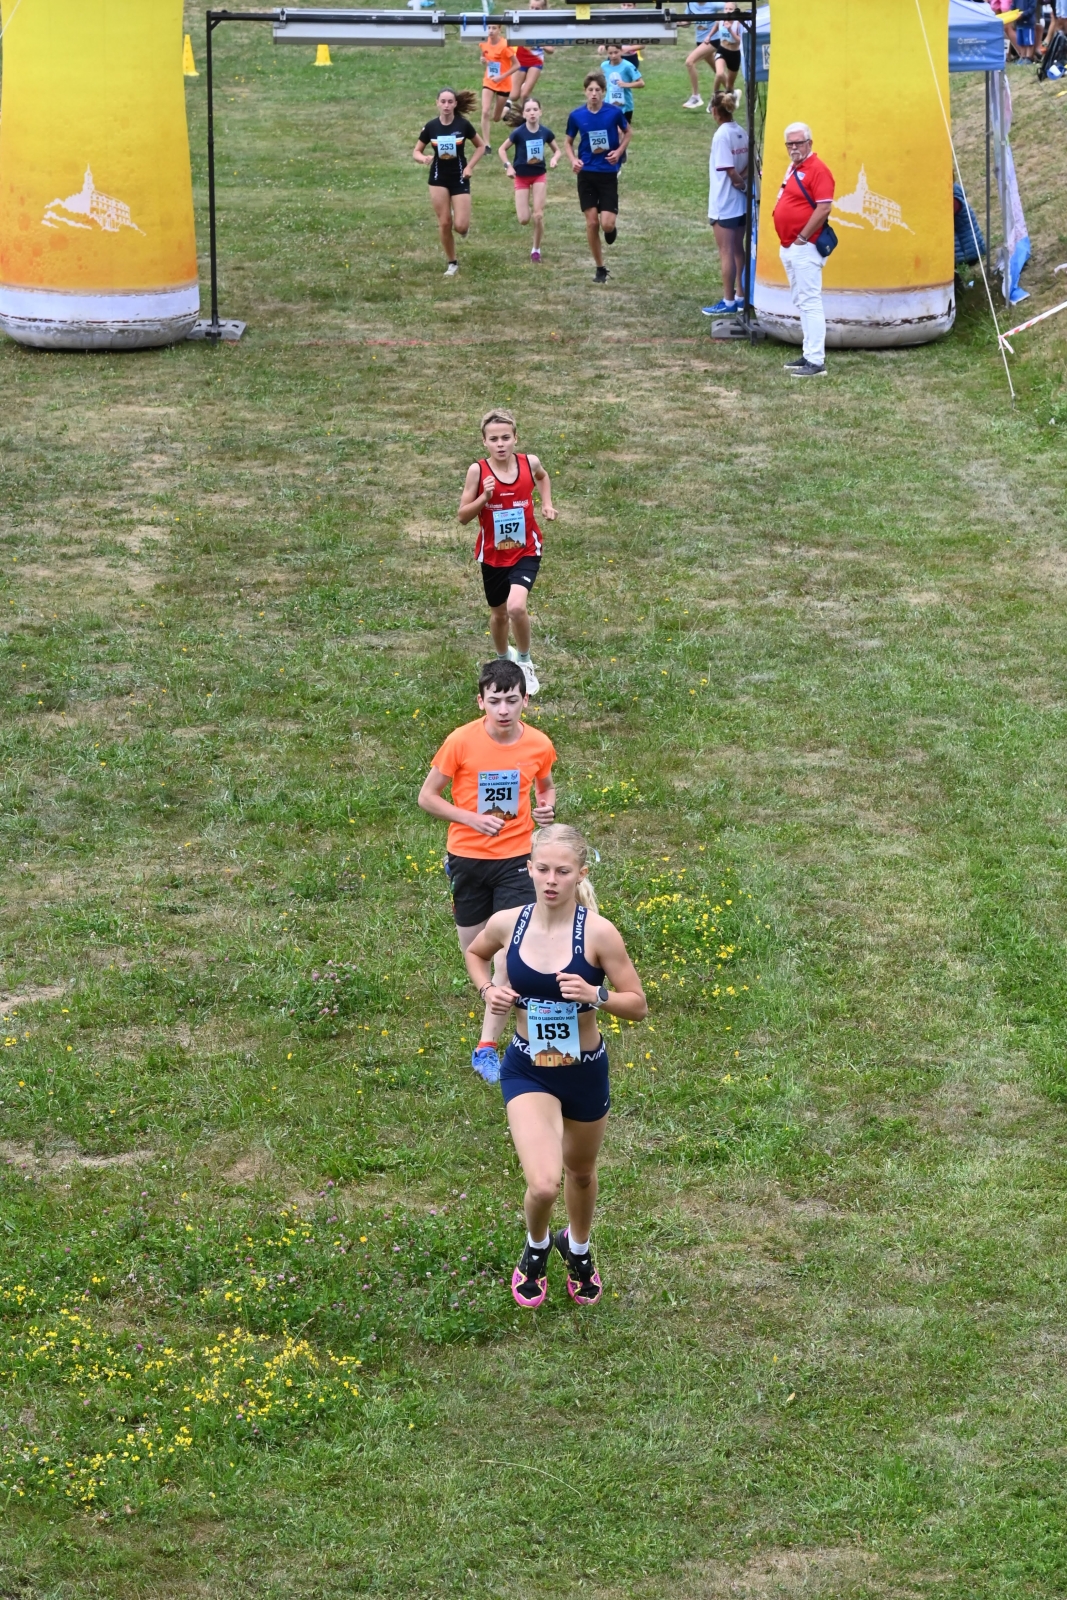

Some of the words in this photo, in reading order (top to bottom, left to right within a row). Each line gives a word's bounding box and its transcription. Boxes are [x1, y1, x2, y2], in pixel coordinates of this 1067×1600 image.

[439, 143, 455, 151] 253
[591, 137, 607, 146] 250
[530, 147, 541, 155] 151
[500, 522, 519, 534] 157
[484, 787, 512, 802] 251
[513, 919, 526, 944] PRO
[575, 912, 584, 940] NIKE
[535, 1023, 571, 1040] 153
